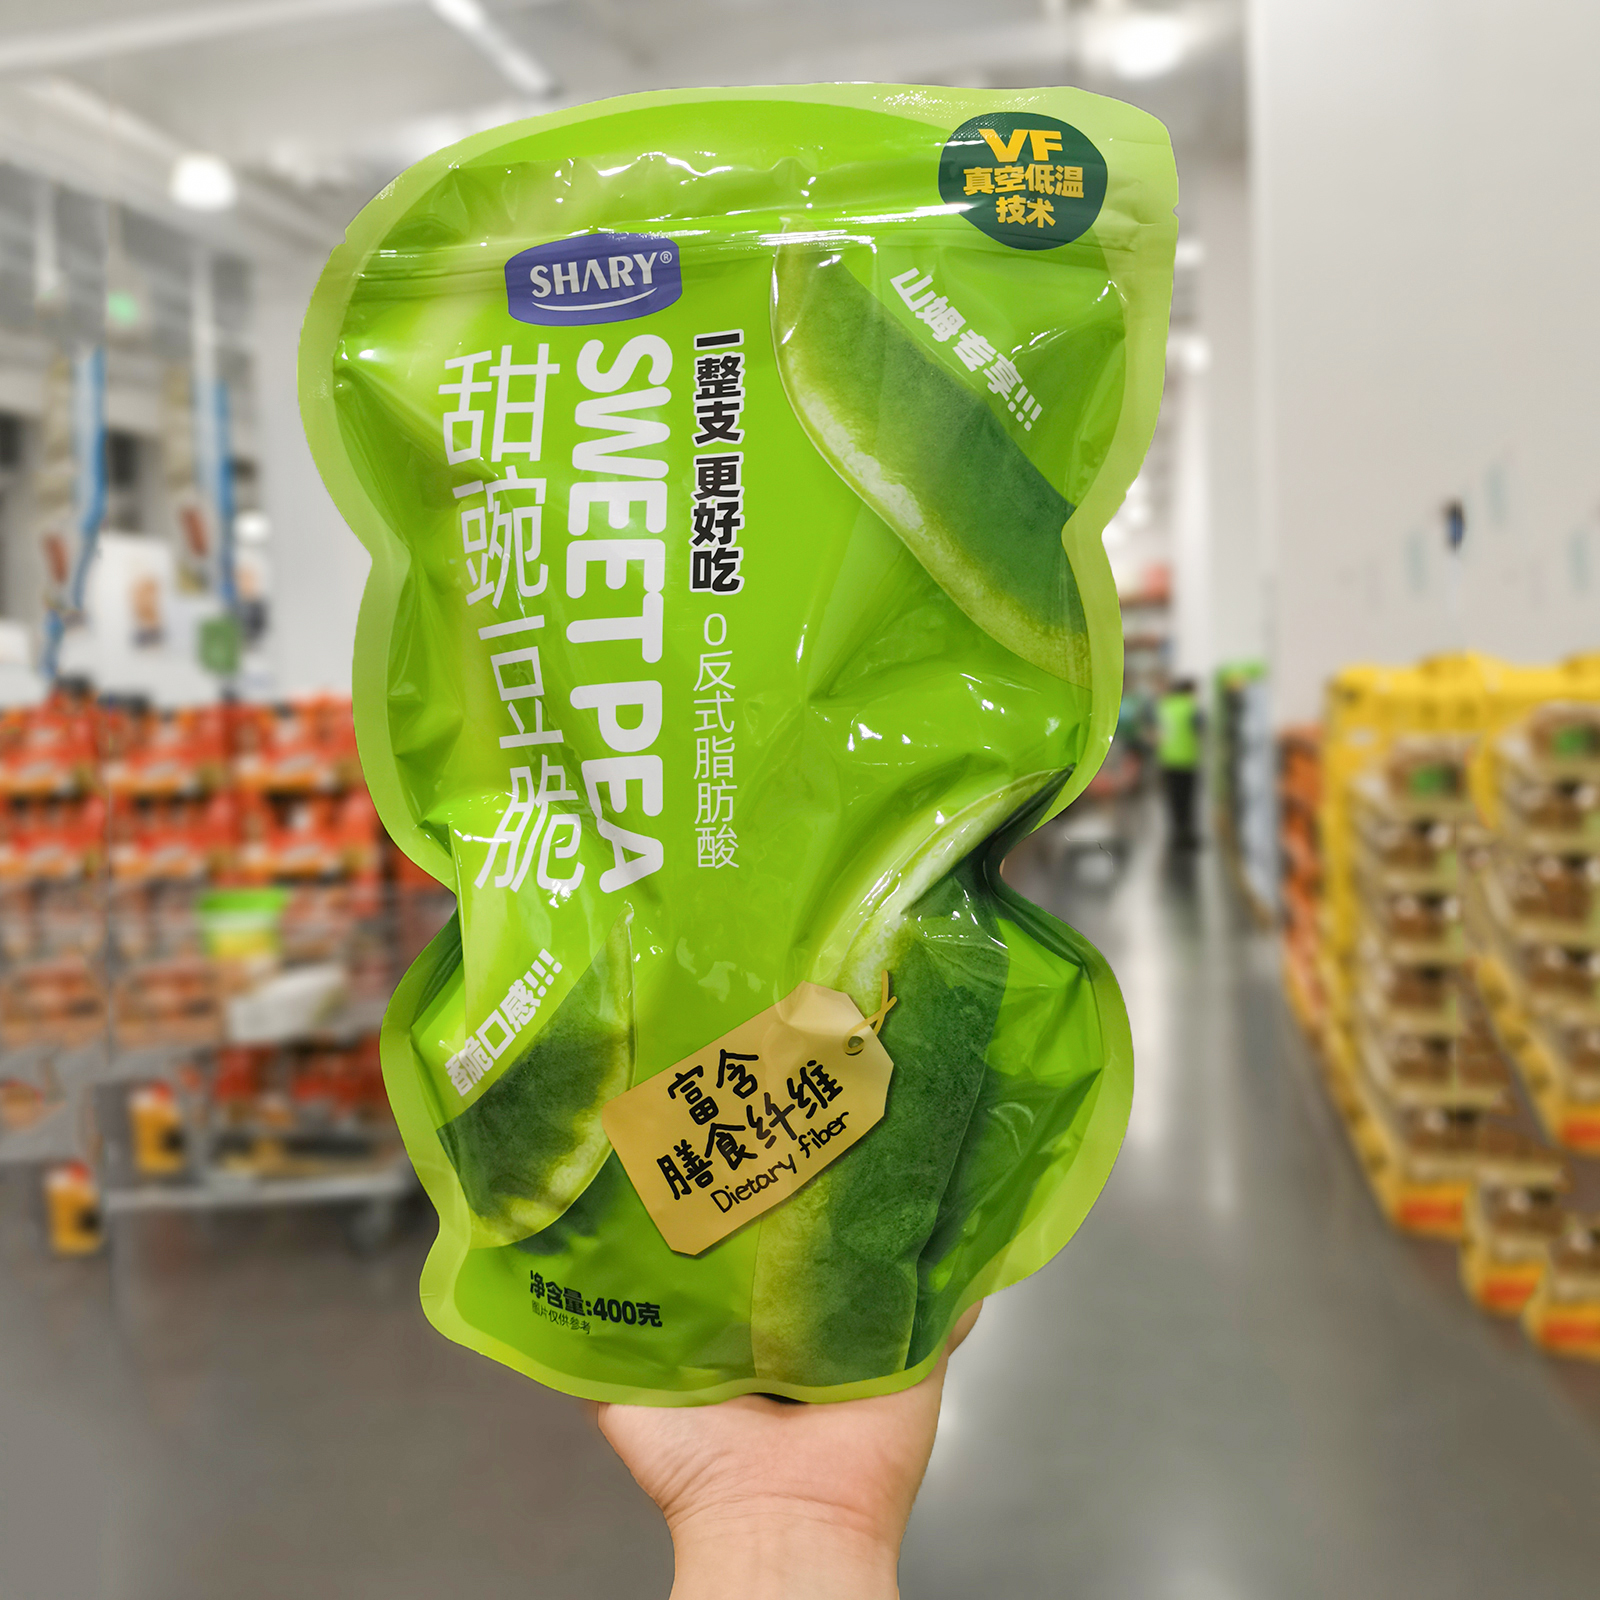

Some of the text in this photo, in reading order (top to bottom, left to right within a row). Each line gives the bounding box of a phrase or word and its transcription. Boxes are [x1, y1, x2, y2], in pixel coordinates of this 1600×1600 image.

[963, 163, 1084, 199] 真空低温
[978, 128, 1063, 163] VF
[996, 195, 1056, 229] 技术
[438, 343, 585, 893] 甜豌豆脆
[566, 334, 673, 893] SWEET PEA
[693, 613, 740, 869] 0反式脂肪酸
[656, 1060, 844, 1201] 膳食纤维
[667, 1048, 759, 1126] 富含
[710, 1112, 849, 1213] Dietary fiber
[532, 1300, 591, 1335] 图片仅供参考
